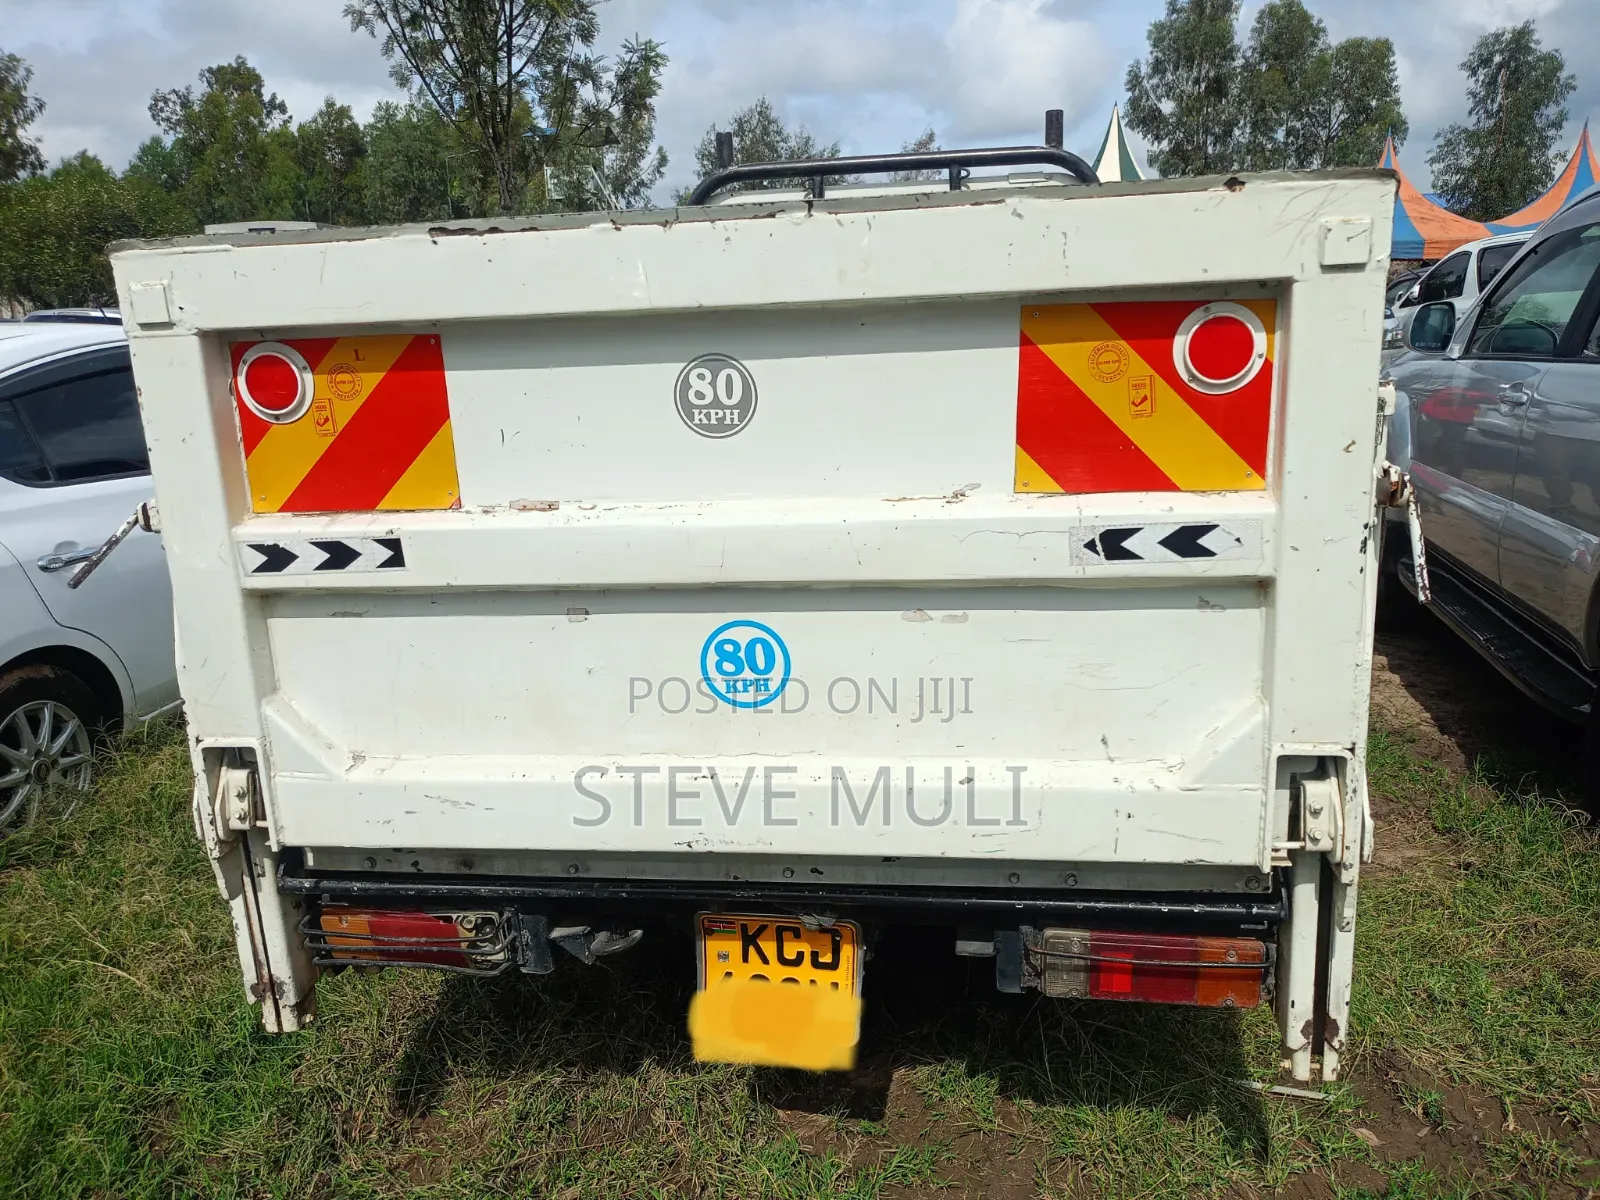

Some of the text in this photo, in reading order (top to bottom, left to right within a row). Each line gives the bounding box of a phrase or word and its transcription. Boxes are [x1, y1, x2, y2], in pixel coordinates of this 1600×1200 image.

[353, 349, 365, 361] L
[1090, 344, 1127, 364] SUPERIOR QUALITY
[329, 365, 360, 384] SUPERIOR QUALITY
[687, 367, 743, 406] 80
[692, 409, 741, 425] KPH
[714, 637, 776, 677] 80
[724, 678, 771, 694] KPH
[740, 922, 842, 971] KCJ
